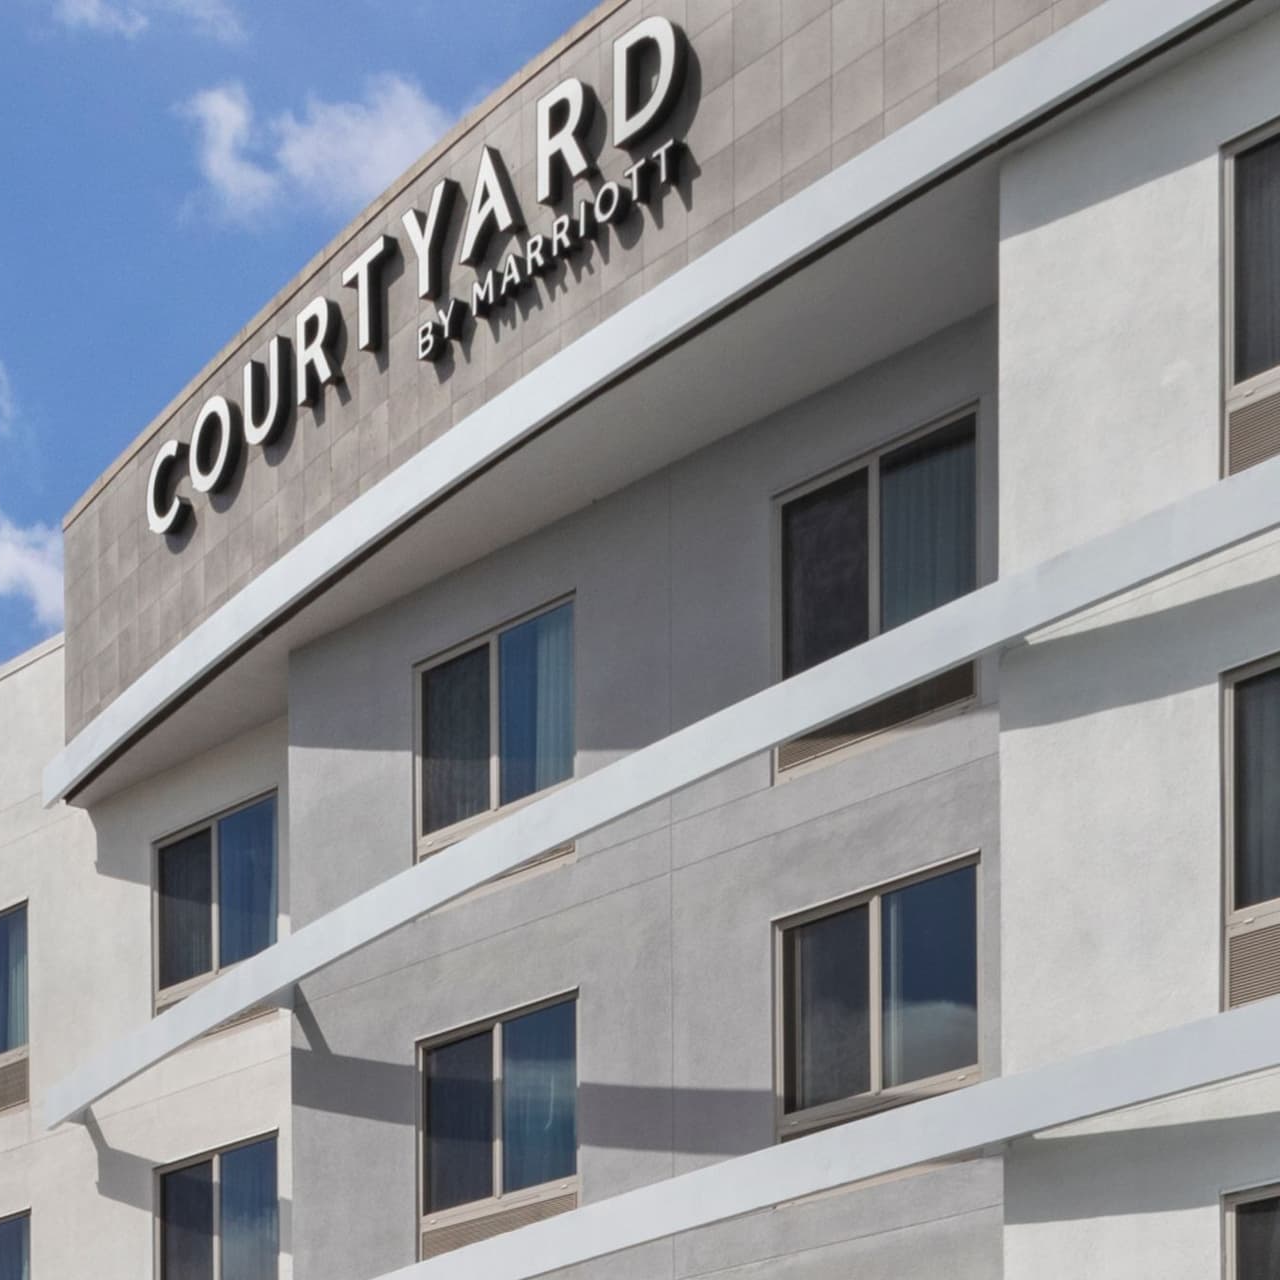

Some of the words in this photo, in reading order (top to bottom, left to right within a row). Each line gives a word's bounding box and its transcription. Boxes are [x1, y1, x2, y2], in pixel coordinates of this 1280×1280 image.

[146, 15, 680, 535] COURTYARD
[416, 299, 458, 361] BY
[471, 139, 678, 317] MARRIOTT
